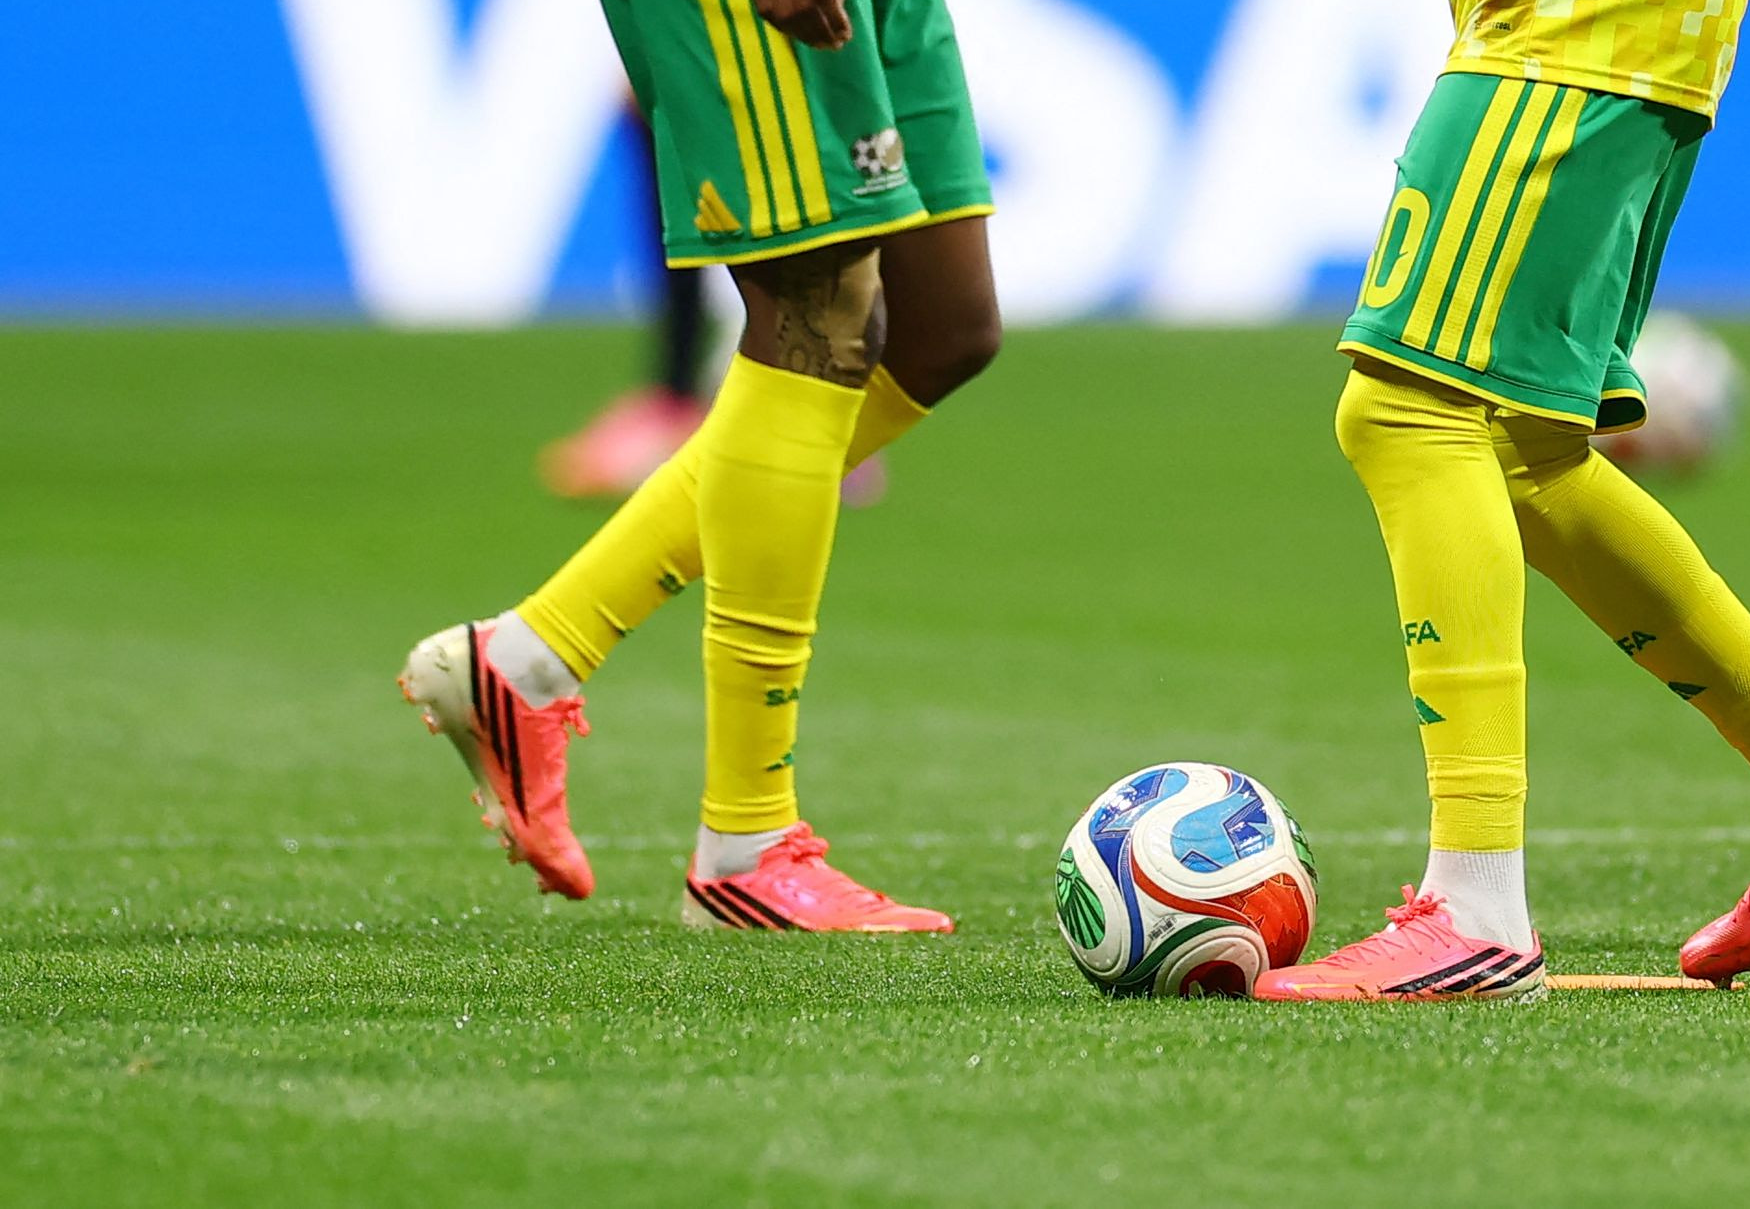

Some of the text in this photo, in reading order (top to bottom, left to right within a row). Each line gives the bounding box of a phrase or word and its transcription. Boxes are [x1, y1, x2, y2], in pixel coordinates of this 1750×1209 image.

[1358, 186, 1431, 309] 0
[1404, 619, 1441, 647] FA
[1615, 630, 1657, 657] FA
